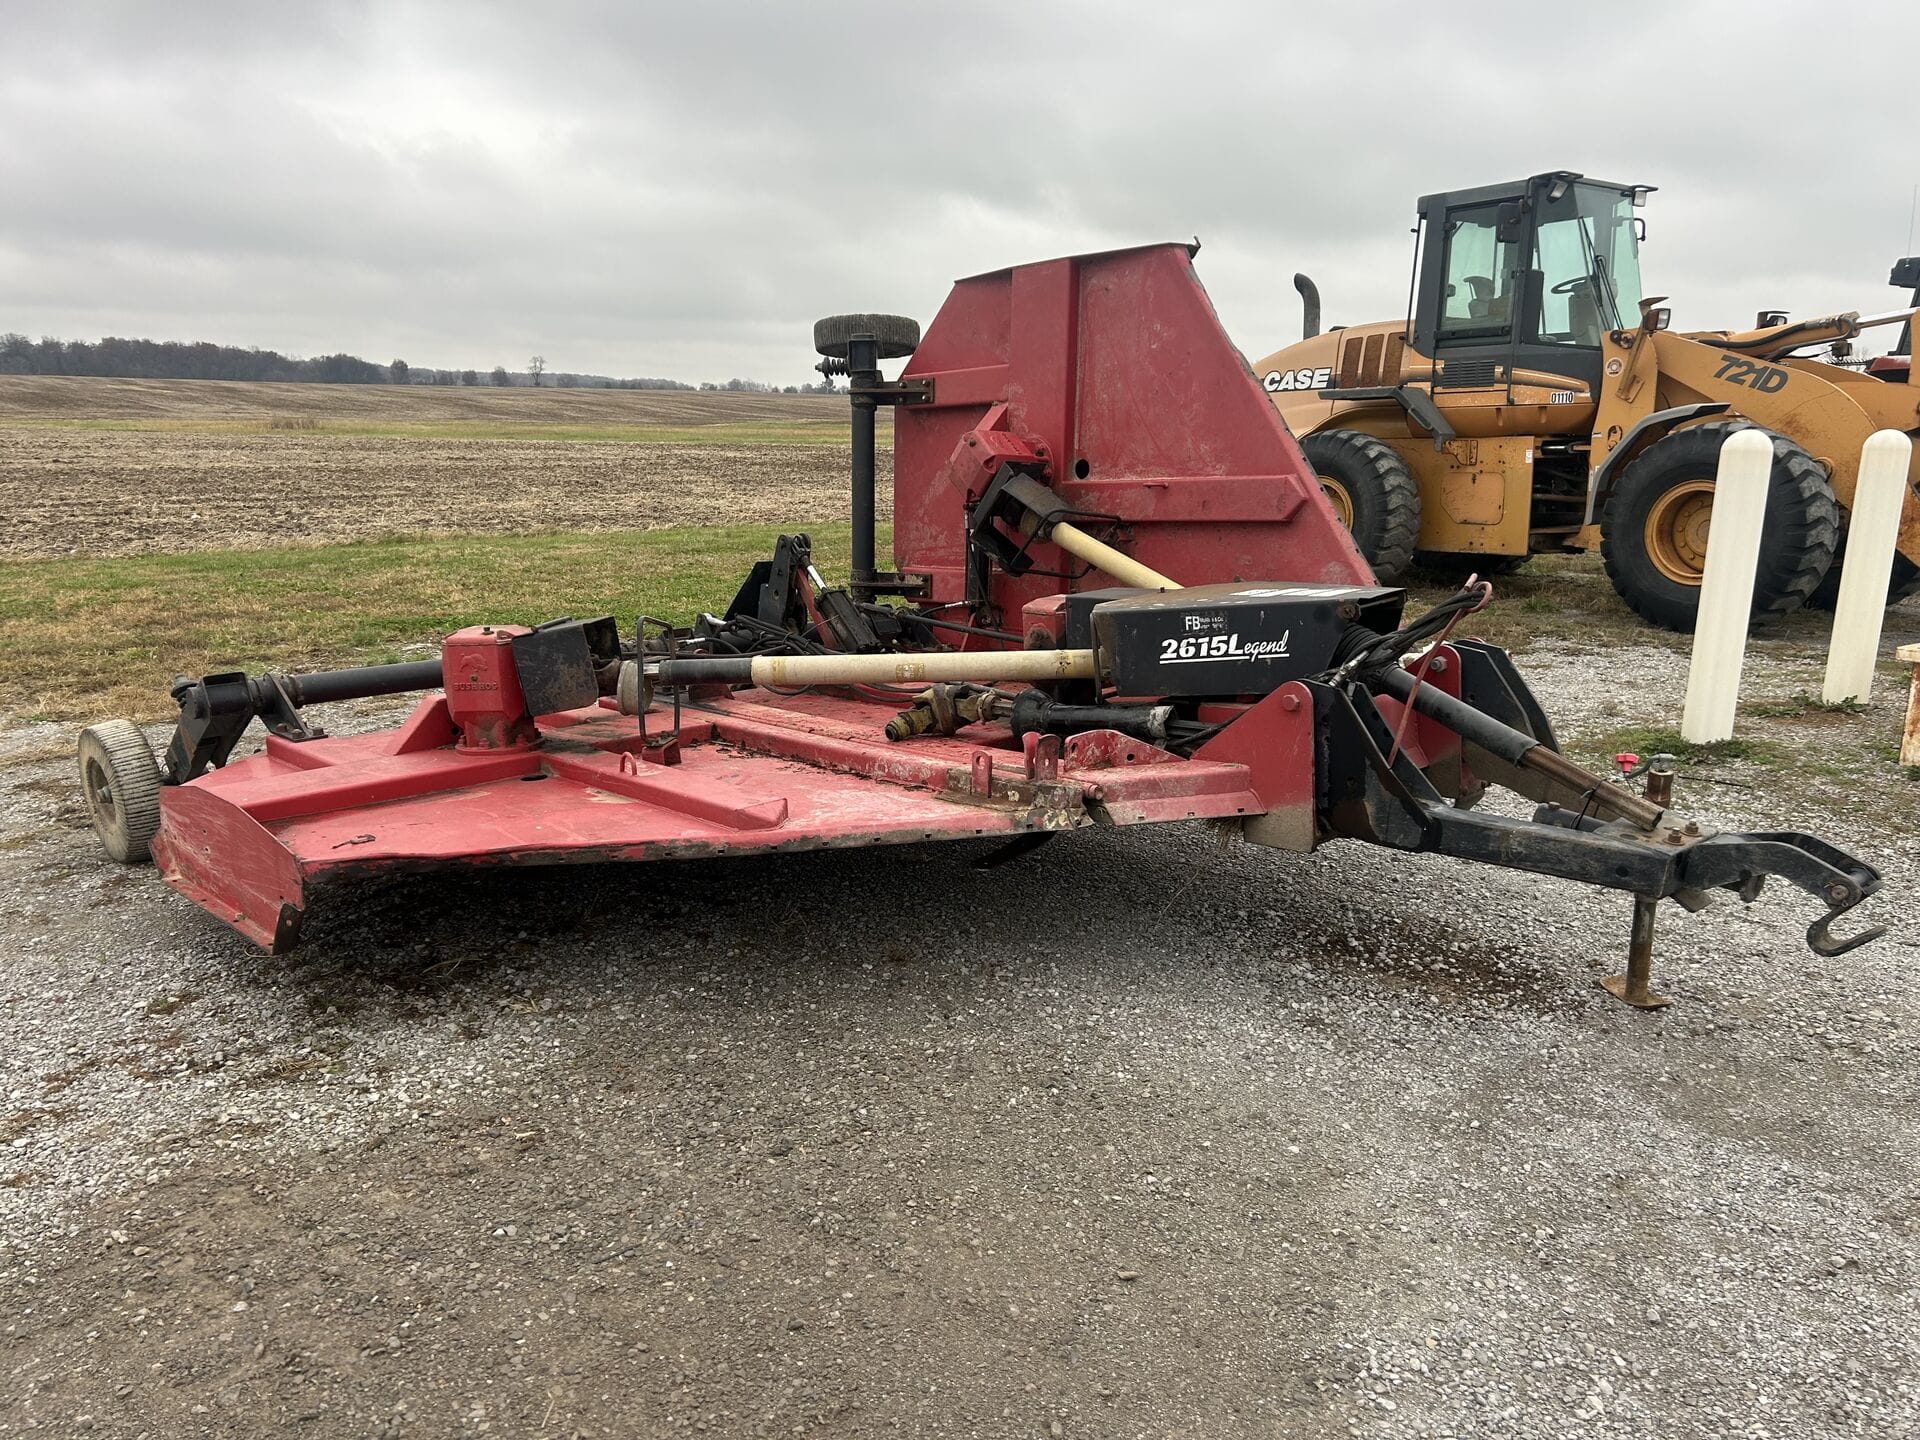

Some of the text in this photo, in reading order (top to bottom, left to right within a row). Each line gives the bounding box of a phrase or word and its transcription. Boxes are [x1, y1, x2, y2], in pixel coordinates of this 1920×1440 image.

[1263, 368, 1332, 392] CASE
[1714, 354, 1788, 393] 721D
[1551, 391, 1574, 403] 01110
